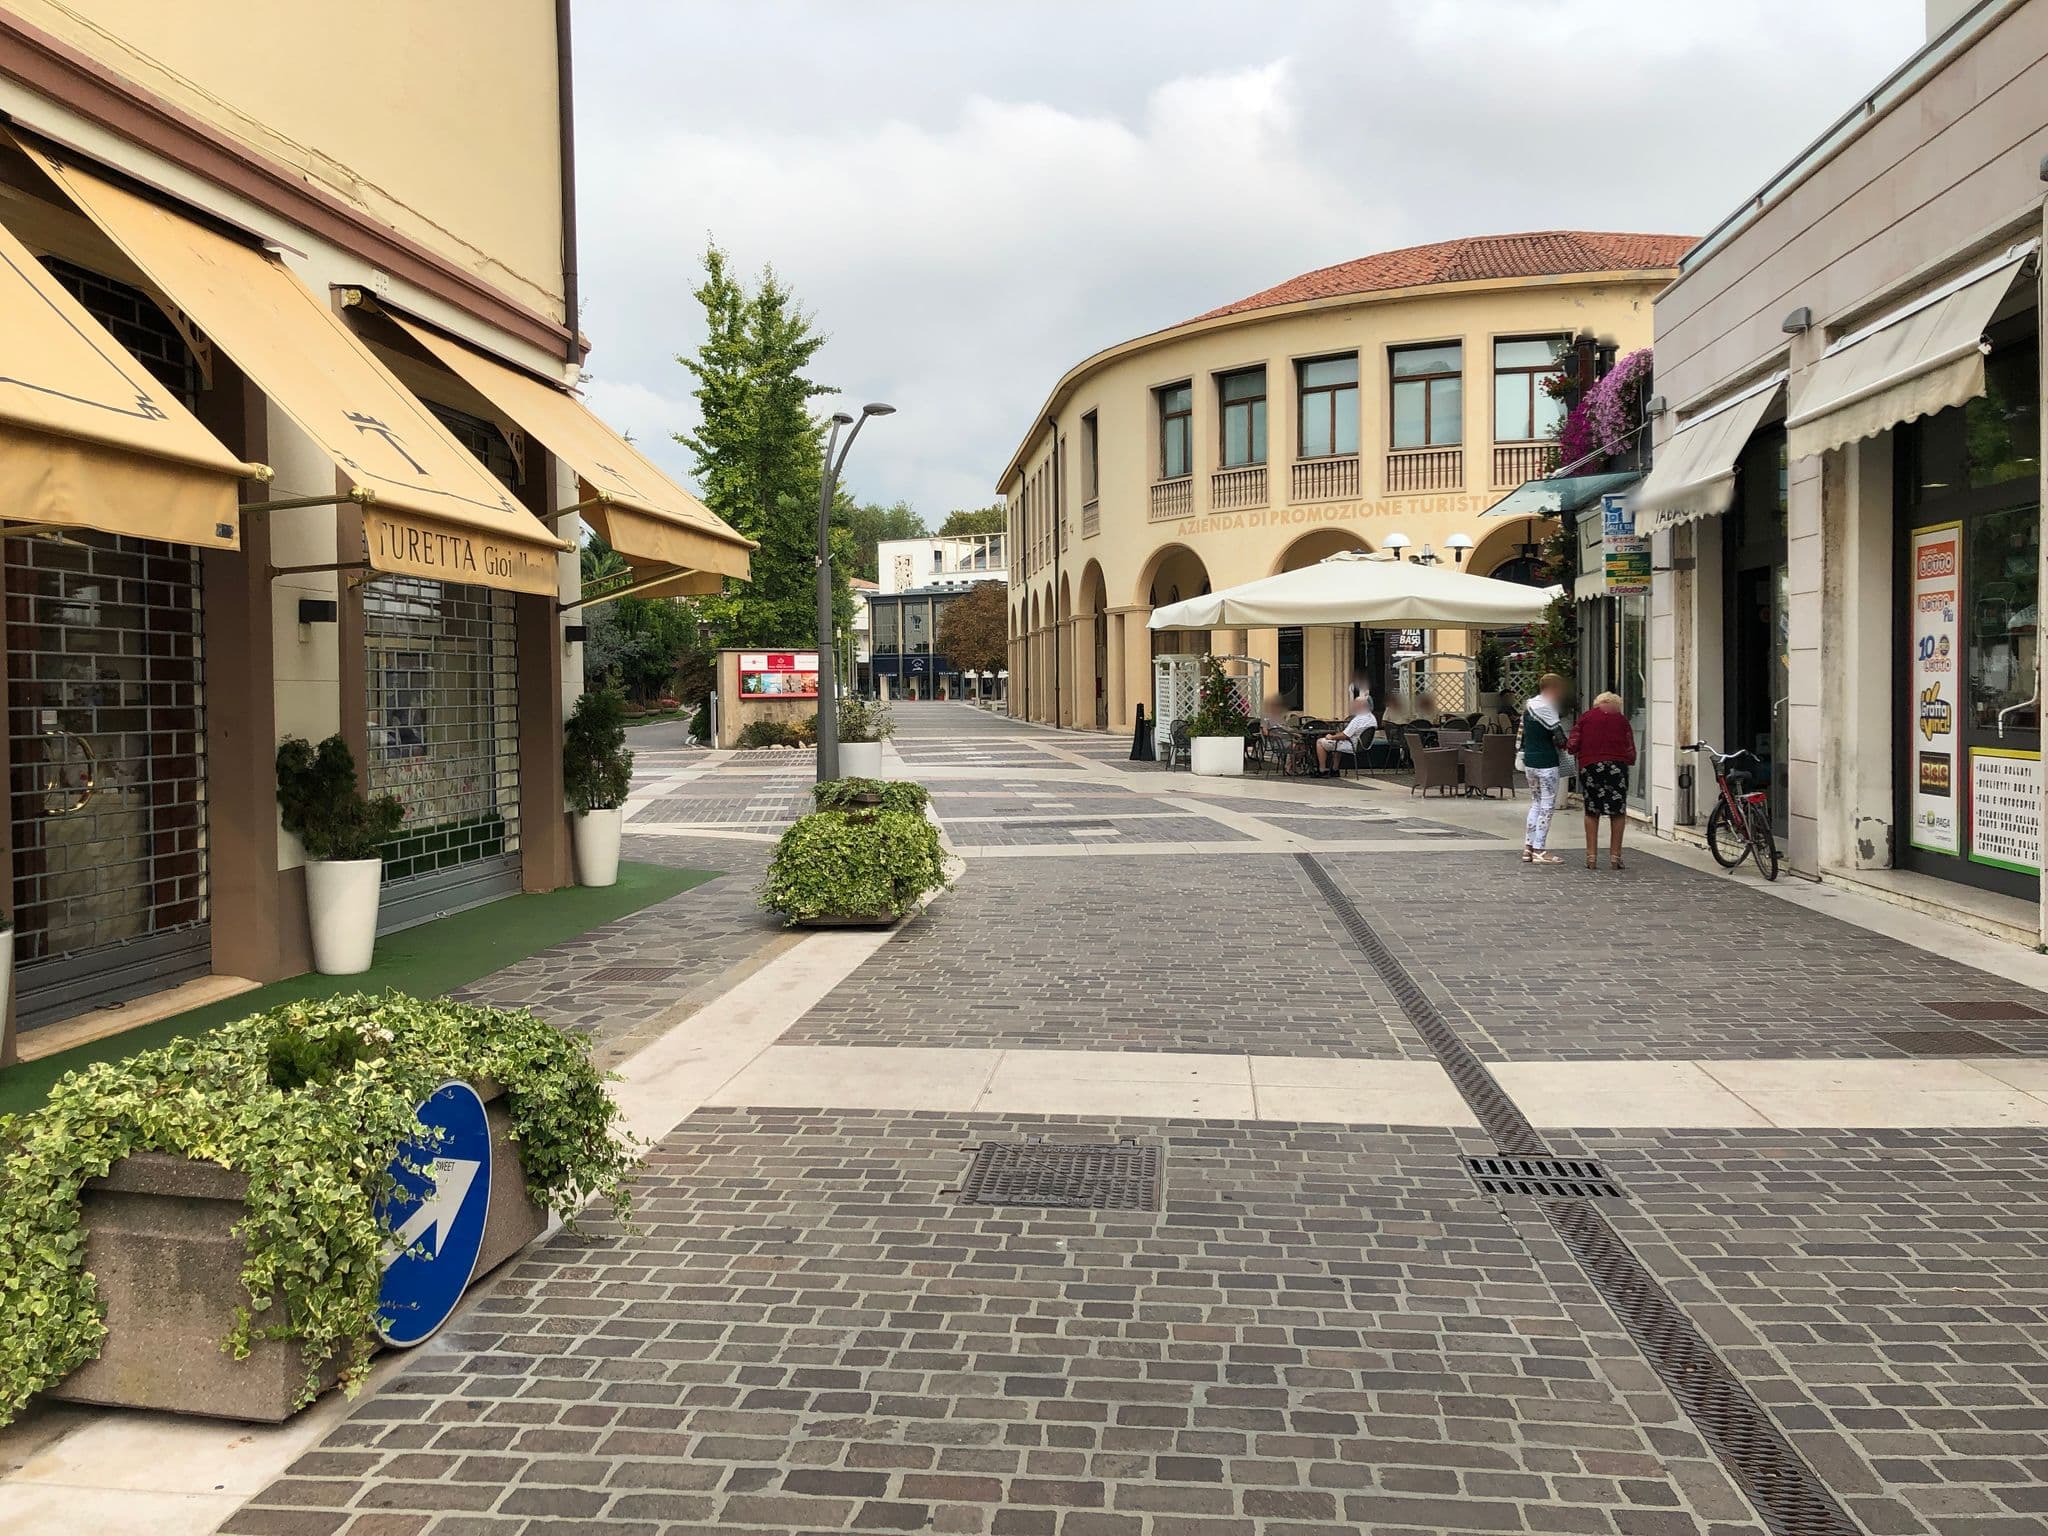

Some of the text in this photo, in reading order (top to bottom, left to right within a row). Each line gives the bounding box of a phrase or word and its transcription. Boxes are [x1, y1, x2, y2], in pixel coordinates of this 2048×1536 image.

[1177, 513, 1244, 536] AZIENDA
[1249, 511, 1267, 527] DI
[1270, 500, 1402, 525] PROMOZIONE
[1920, 553, 1953, 576] LOTTO
[1918, 635, 1935, 661] 10
[1921, 702, 1947, 717] Gratta
[1979, 779, 2011, 791] BIGLIETTI
[2013, 783, 2026, 793] BUS
[1979, 793, 1990, 804] FAX
[1999, 796, 2035, 810] FOTOCOPIE
[1979, 809, 2039, 826] RICARICHE CELLUL
[2000, 822, 2038, 836] PREPAGATE
[1979, 832, 2015, 847] PAGAMENTO
[1979, 842, 2021, 857] LOTTOMATICA
[435, 1161, 455, 1171] SWEET
